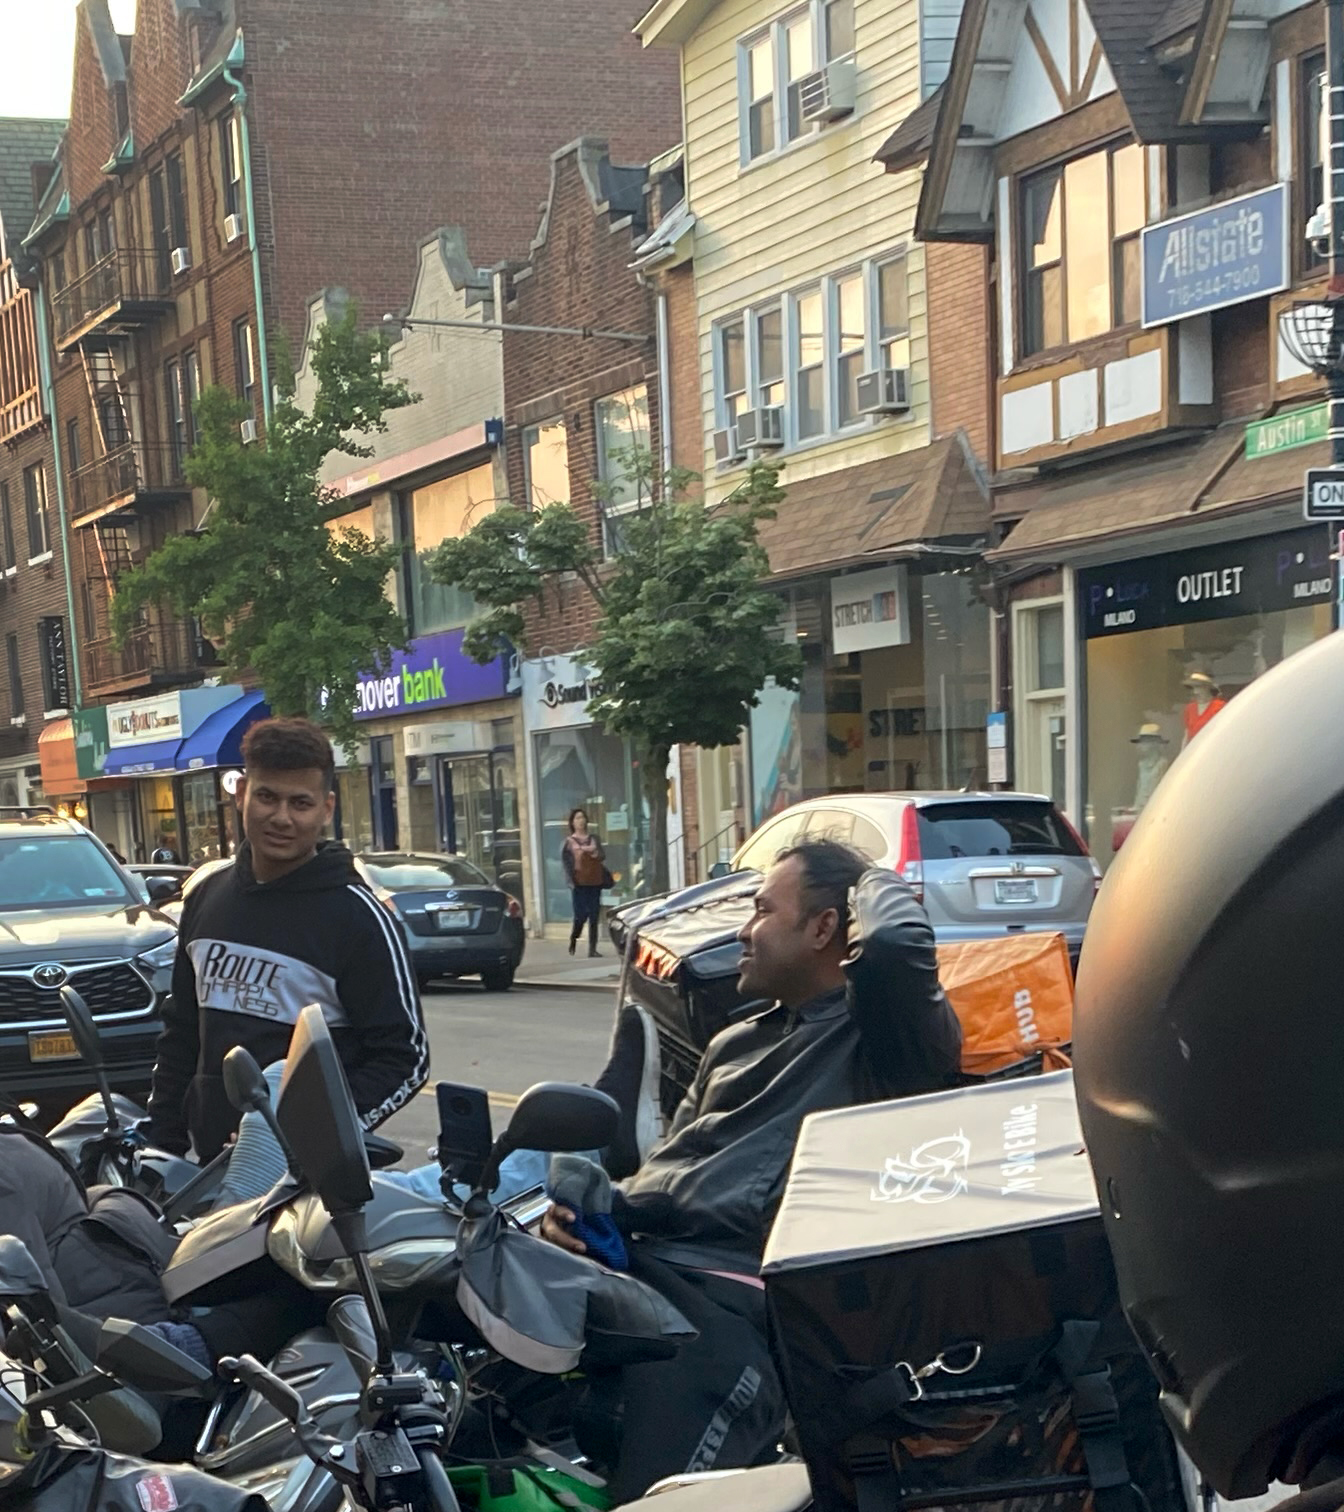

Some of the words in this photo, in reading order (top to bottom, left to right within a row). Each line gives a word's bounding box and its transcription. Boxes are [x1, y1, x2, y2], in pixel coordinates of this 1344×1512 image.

[1158, 208, 1264, 283] Allstate
[1257, 415, 1306, 452] Austin
[1177, 566, 1245, 603] OUTLET
[1293, 577, 1332, 599] MILANO
[1103, 608, 1136, 628] MILANO
[56, 652, 68, 705] TAYLOR
[402, 657, 447, 704] bank
[203, 942, 288, 991] ROUTE
